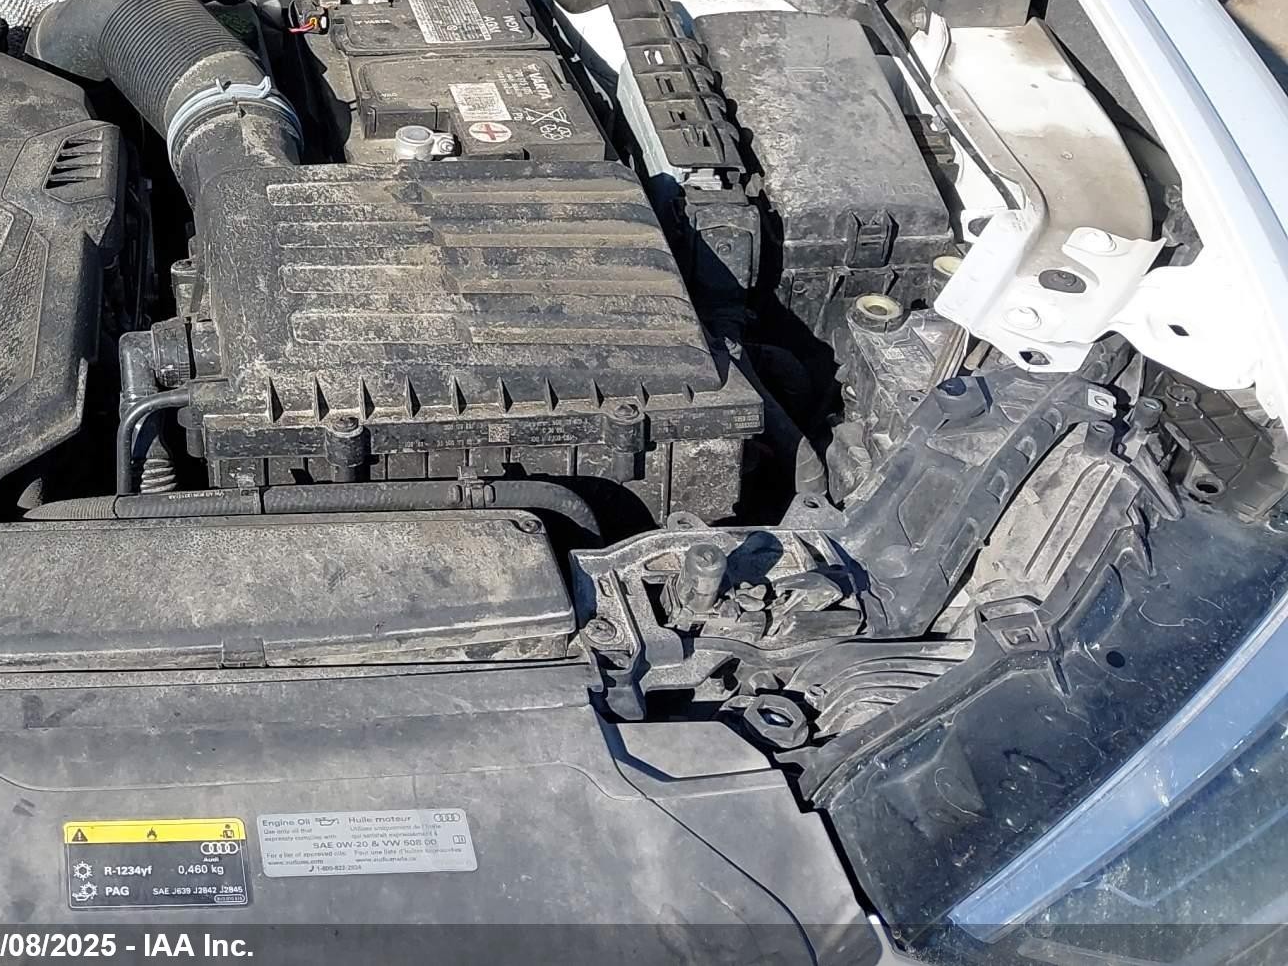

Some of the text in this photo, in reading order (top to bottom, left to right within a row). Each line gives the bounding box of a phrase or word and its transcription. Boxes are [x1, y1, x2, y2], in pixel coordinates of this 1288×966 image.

[529, 72, 553, 100] VARTA
[262, 818, 310, 828] Engine Oil
[348, 816, 373, 824] Huile
[104, 866, 152, 877] R-1234yf
[211, 864, 224, 875] kg
[105, 886, 130, 896] PAG
